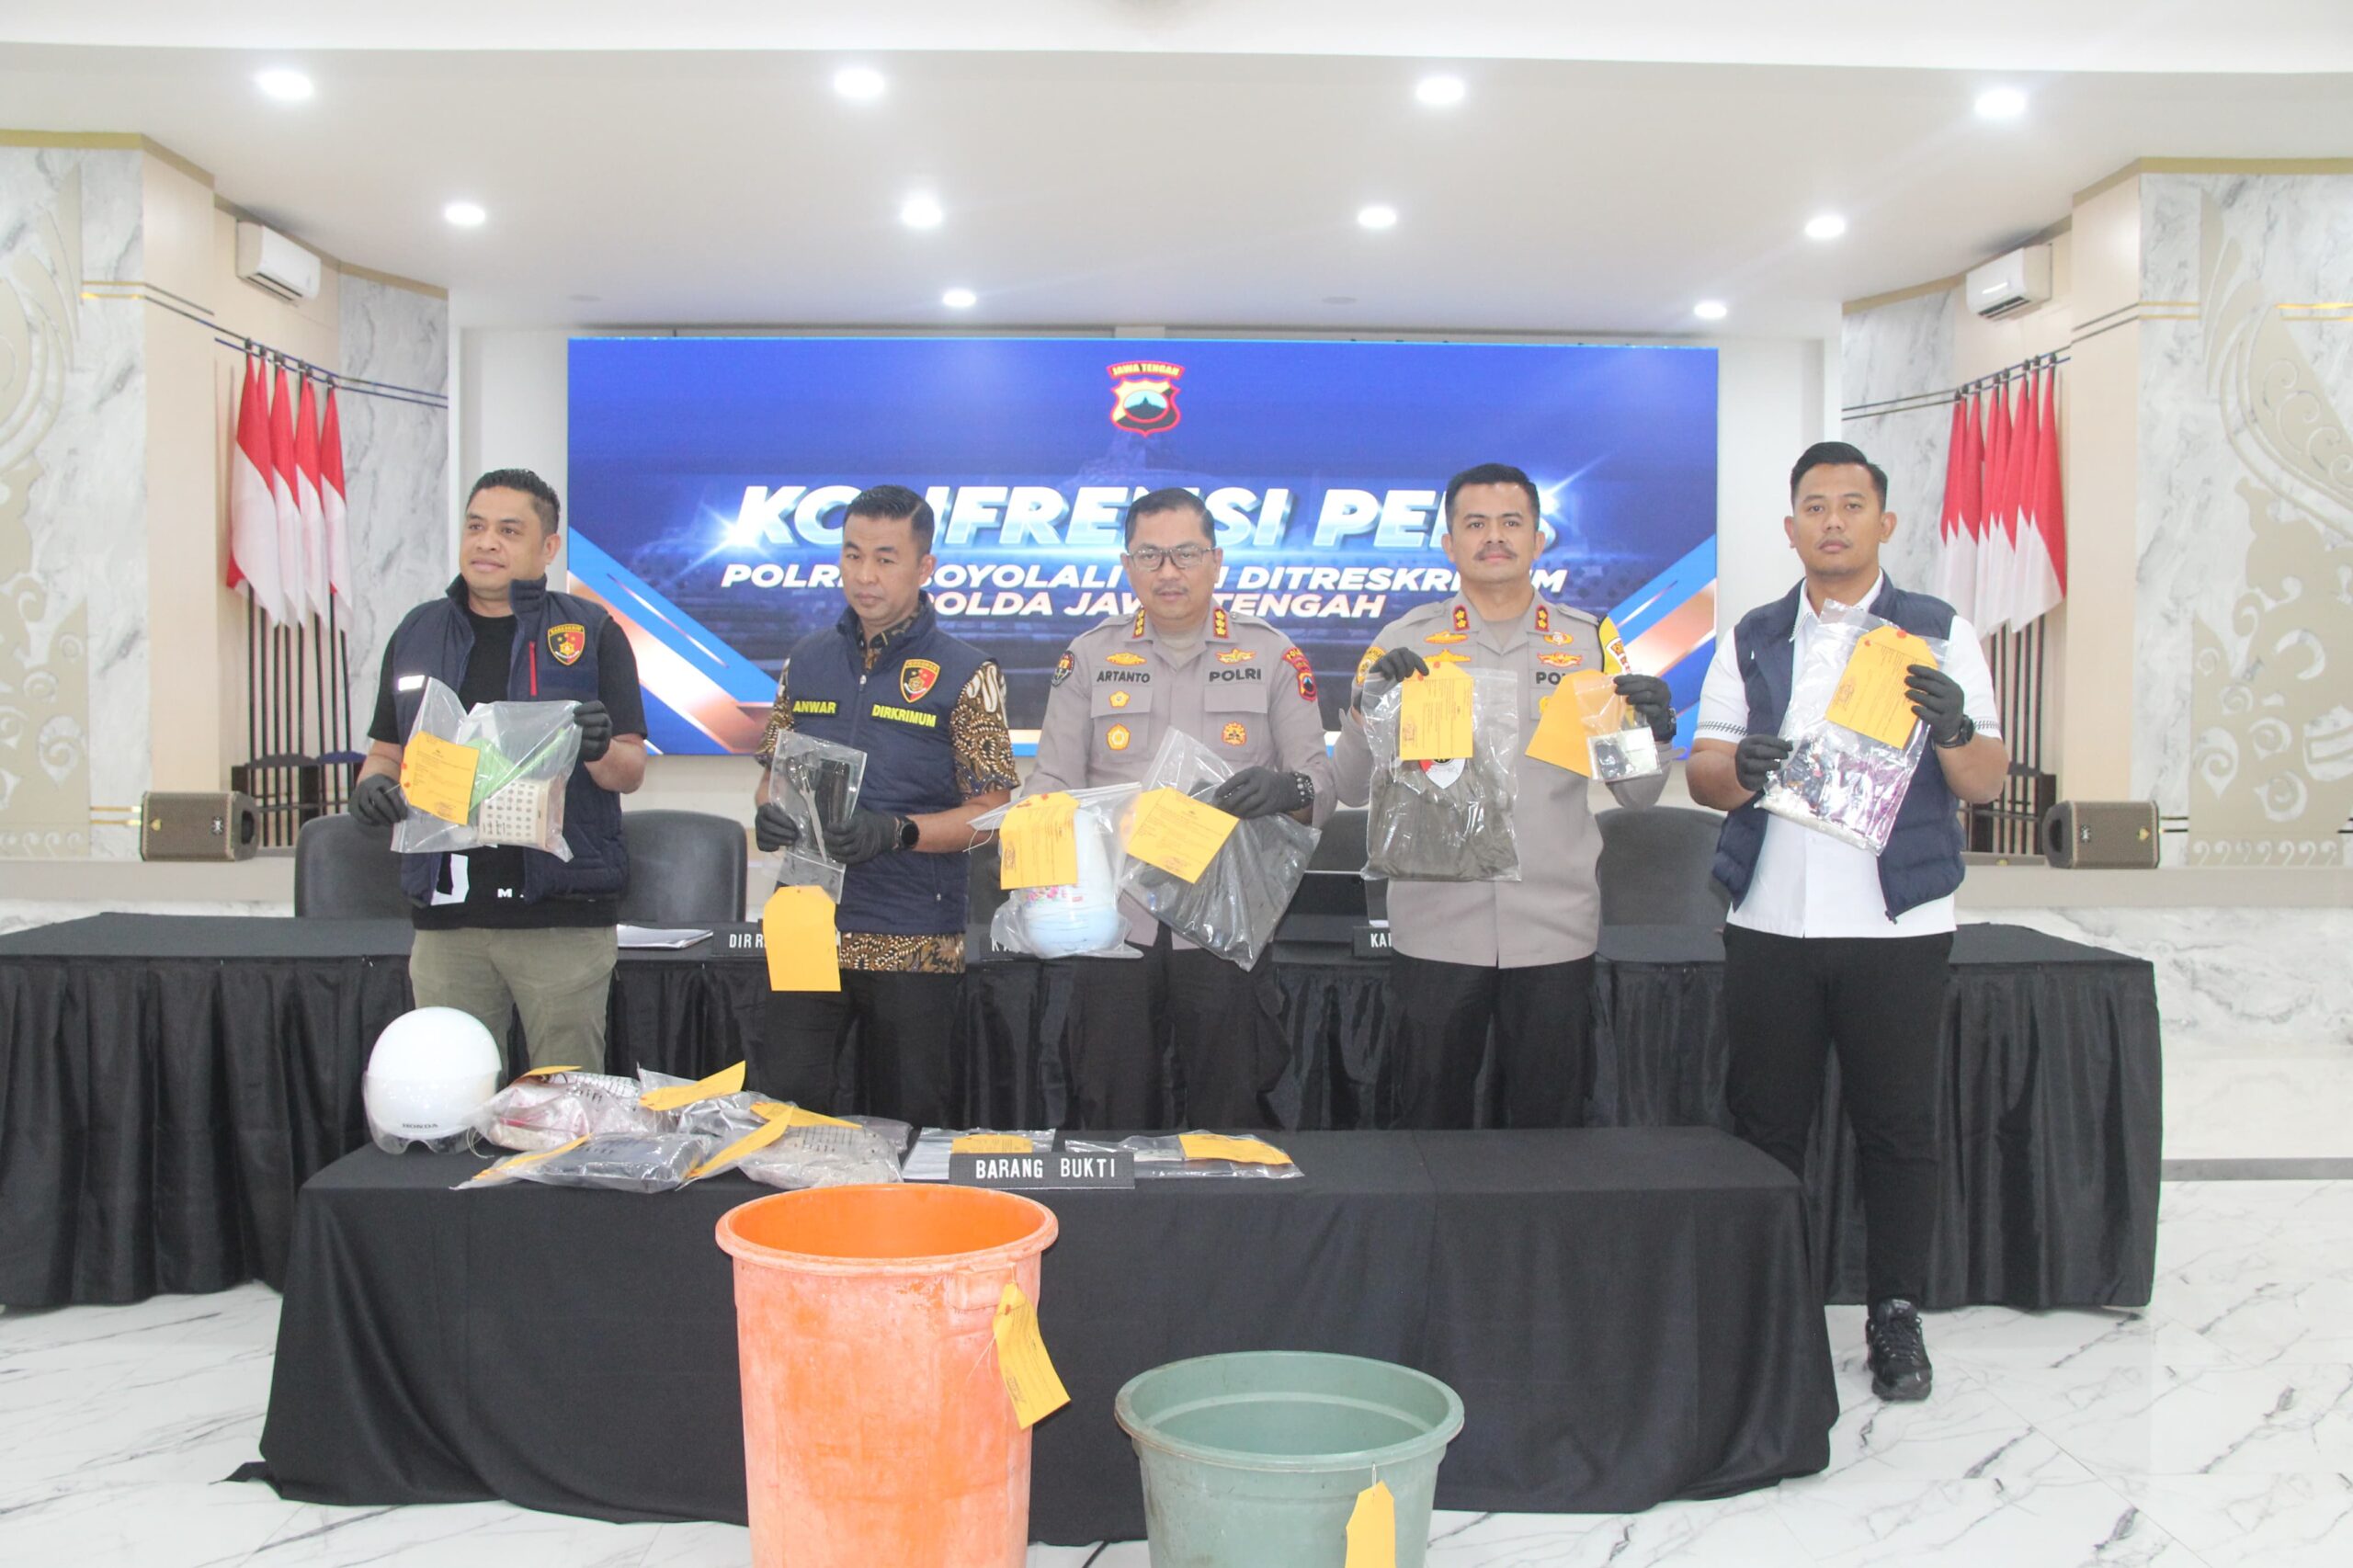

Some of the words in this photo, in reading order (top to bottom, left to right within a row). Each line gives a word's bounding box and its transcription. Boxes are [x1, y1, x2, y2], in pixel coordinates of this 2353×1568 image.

[1111, 363, 1142, 377] JAWA
[1141, 363, 1181, 377] TENGAH
[920, 563, 1123, 588] OYOLALI
[927, 591, 1053, 616] OLDA
[1212, 593, 1387, 619] TENGAH
[1097, 670, 1150, 683] ARTANTO
[1209, 668, 1261, 682] POLRI
[1536, 671, 1565, 685] PO
[792, 700, 836, 714] ANWAR
[871, 704, 937, 727] DIRKRIMUM
[976, 1159, 1044, 1179] BARANG
[1061, 1157, 1115, 1177] BUKTI
